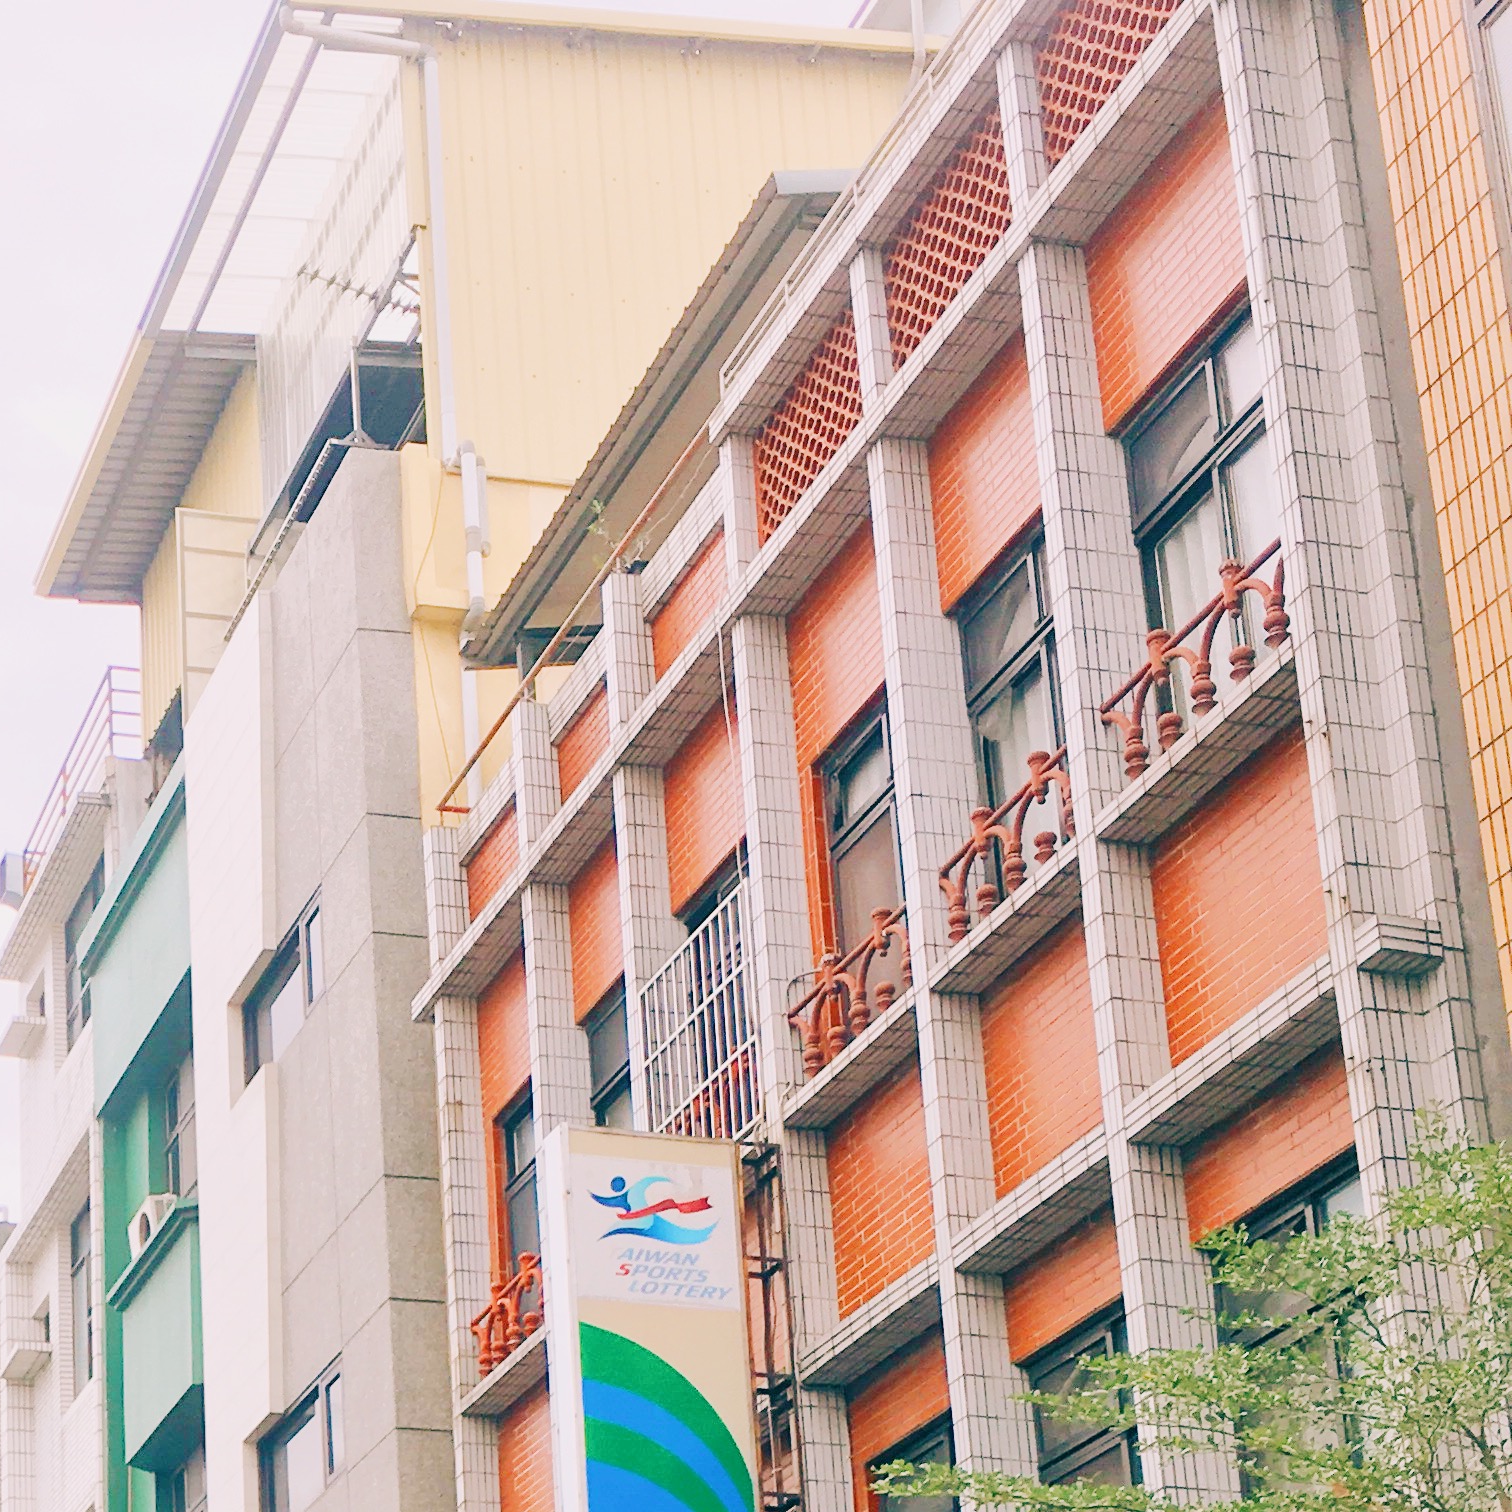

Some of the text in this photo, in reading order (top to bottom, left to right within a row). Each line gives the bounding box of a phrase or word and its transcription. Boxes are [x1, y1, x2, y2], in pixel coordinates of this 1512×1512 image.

[617, 1247, 700, 1266] AIWAN
[615, 1263, 710, 1283] SPORTS
[628, 1280, 732, 1300] LOTTERY
